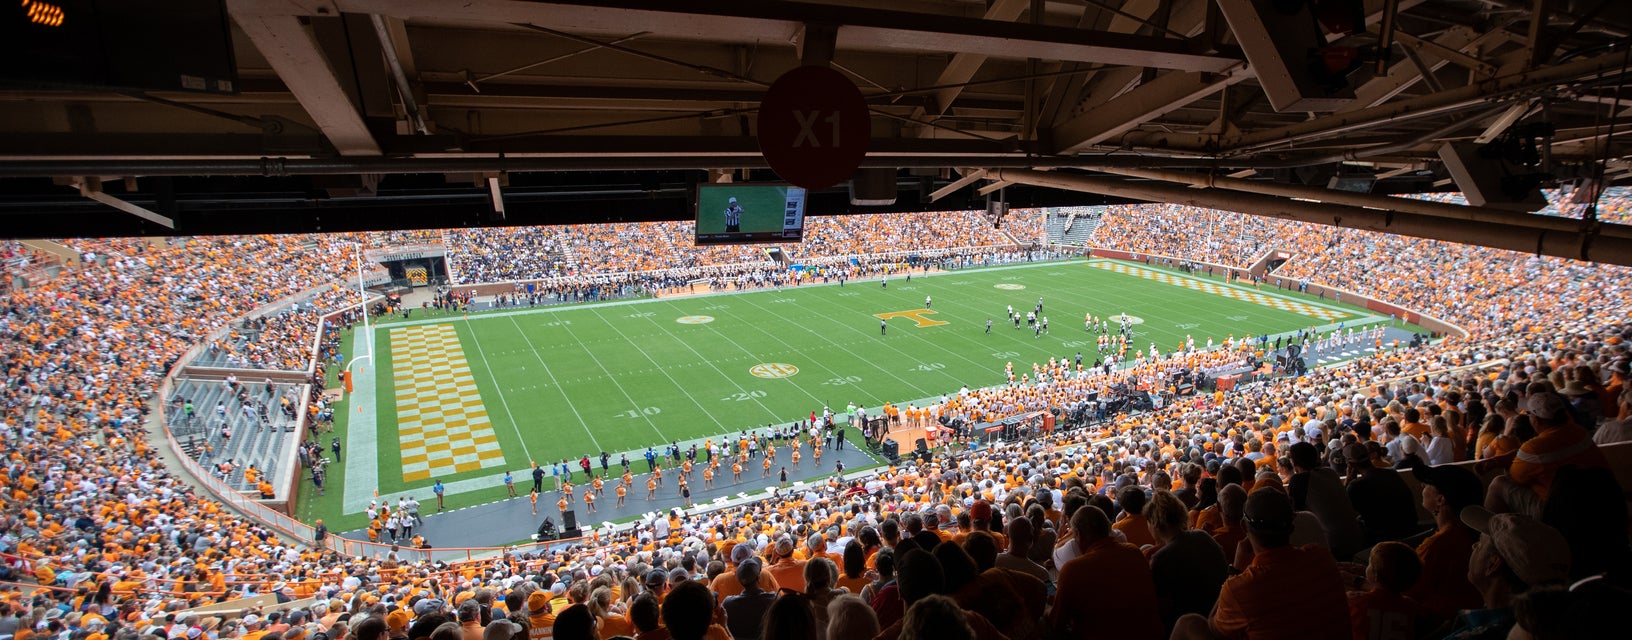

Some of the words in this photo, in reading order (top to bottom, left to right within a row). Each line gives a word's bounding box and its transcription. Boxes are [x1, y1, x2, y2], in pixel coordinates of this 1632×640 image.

[792, 110, 840, 147] X1
[992, 351, 1020, 359] 50
[752, 363, 798, 378] SEC
